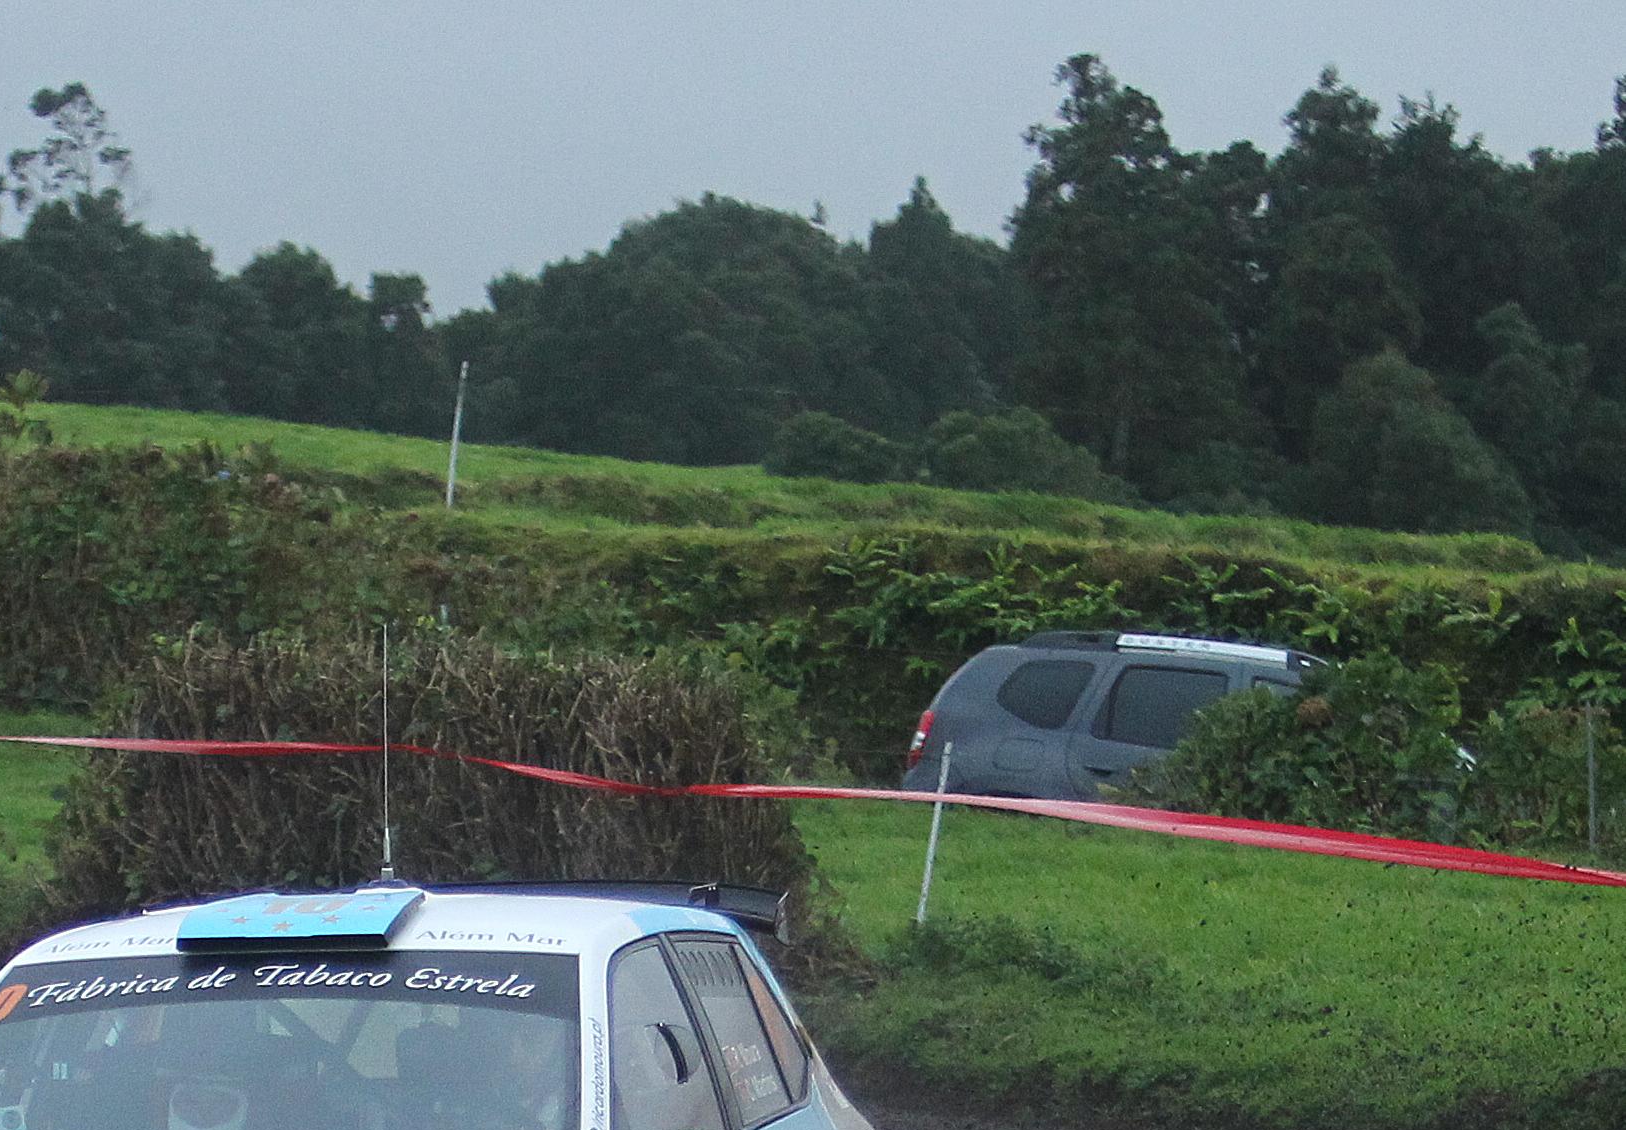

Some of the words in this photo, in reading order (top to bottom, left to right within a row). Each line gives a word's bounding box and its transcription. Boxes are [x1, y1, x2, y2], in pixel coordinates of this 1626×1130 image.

[507, 932, 567, 946] Mar
[27, 973, 179, 1008] Fábrica
[187, 966, 237, 990] de
[253, 964, 392, 988] Tabaco
[405, 968, 536, 999] Estrela
